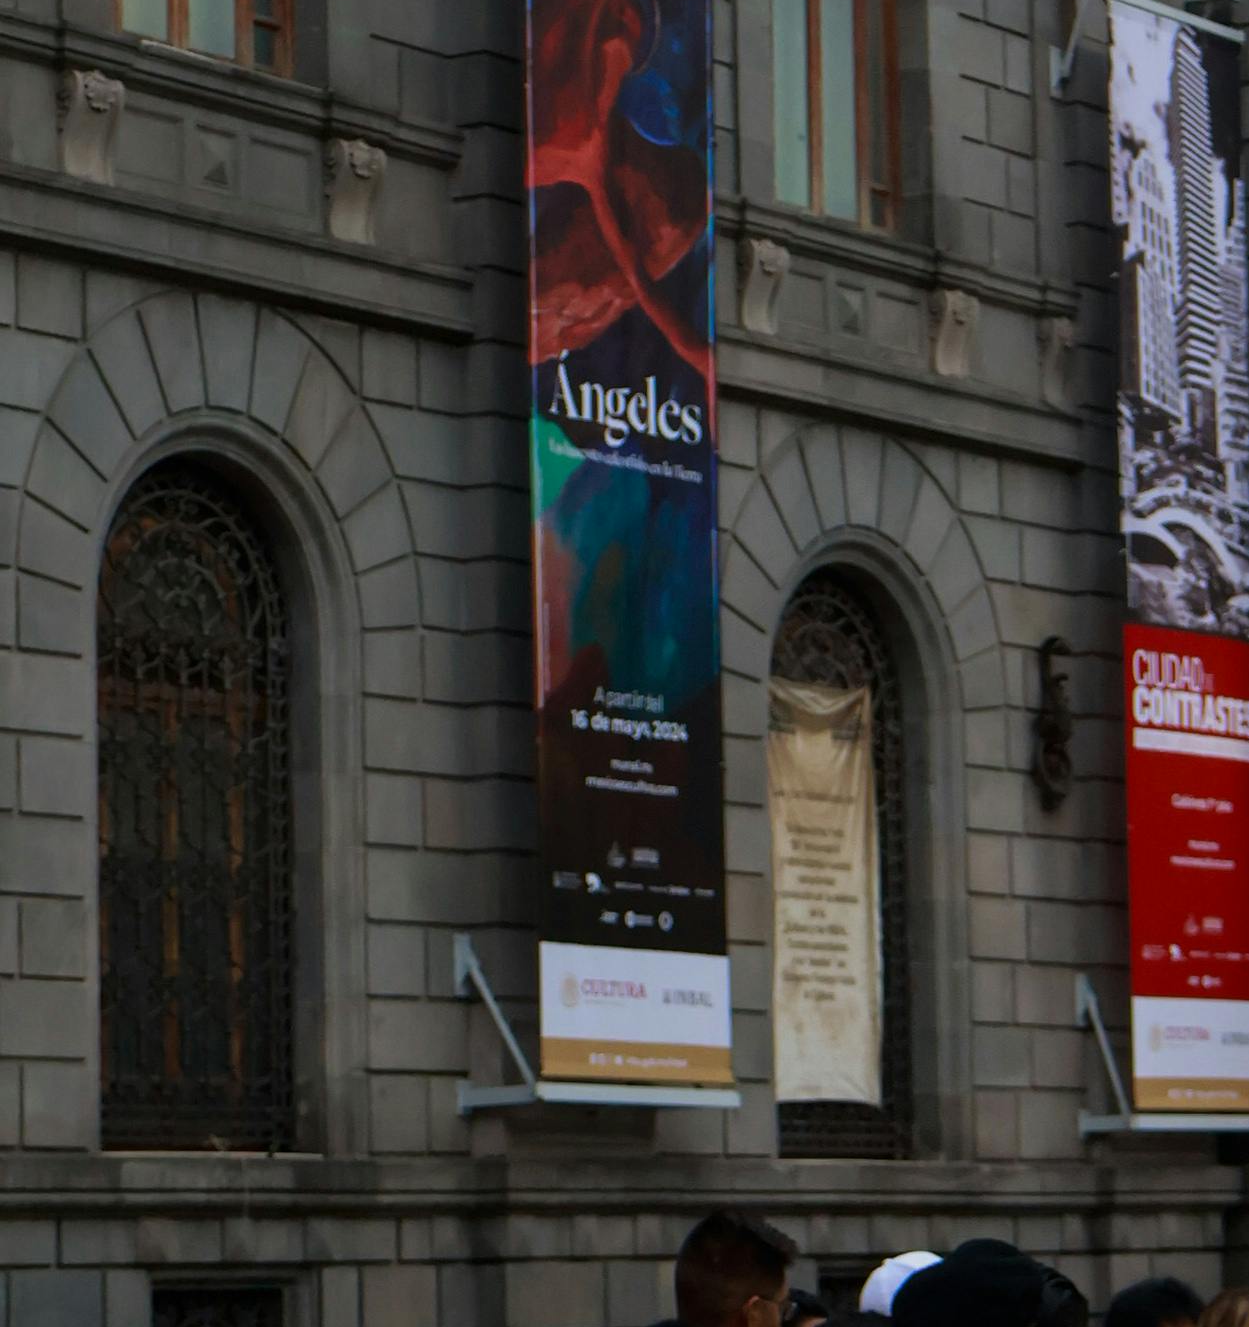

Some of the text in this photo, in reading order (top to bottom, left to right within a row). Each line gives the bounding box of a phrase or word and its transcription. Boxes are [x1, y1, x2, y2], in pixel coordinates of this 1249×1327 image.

[1132, 648, 1204, 692] CIUDAD
[570, 709, 589, 730] 16
[590, 712, 610, 733] de
[652, 720, 689, 743] 2024
[580, 978, 648, 1000] CULTURA
